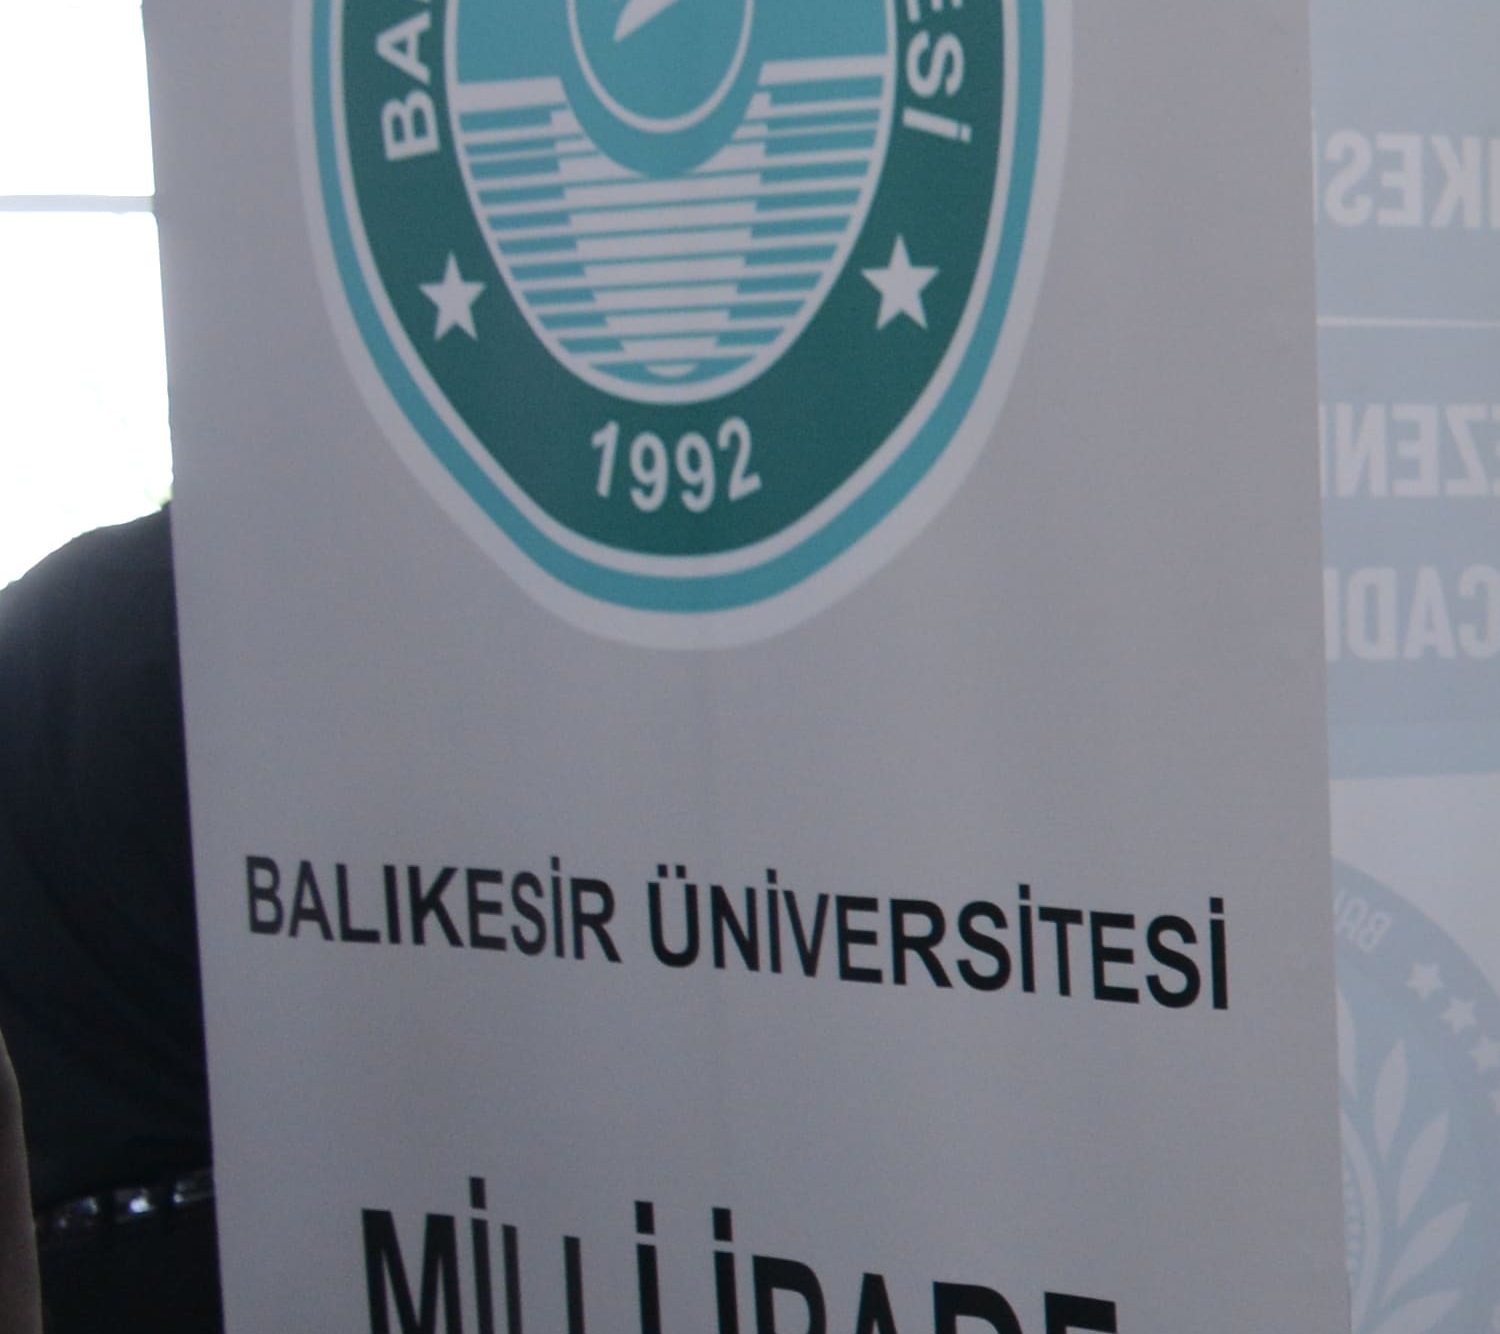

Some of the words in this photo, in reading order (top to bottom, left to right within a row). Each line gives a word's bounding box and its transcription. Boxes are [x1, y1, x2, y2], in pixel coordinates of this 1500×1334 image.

[590, 416, 762, 513] 1992
[245, 855, 622, 965] BALIKESİR
[646, 863, 1229, 1011] ÜNİVERSİTESİ
